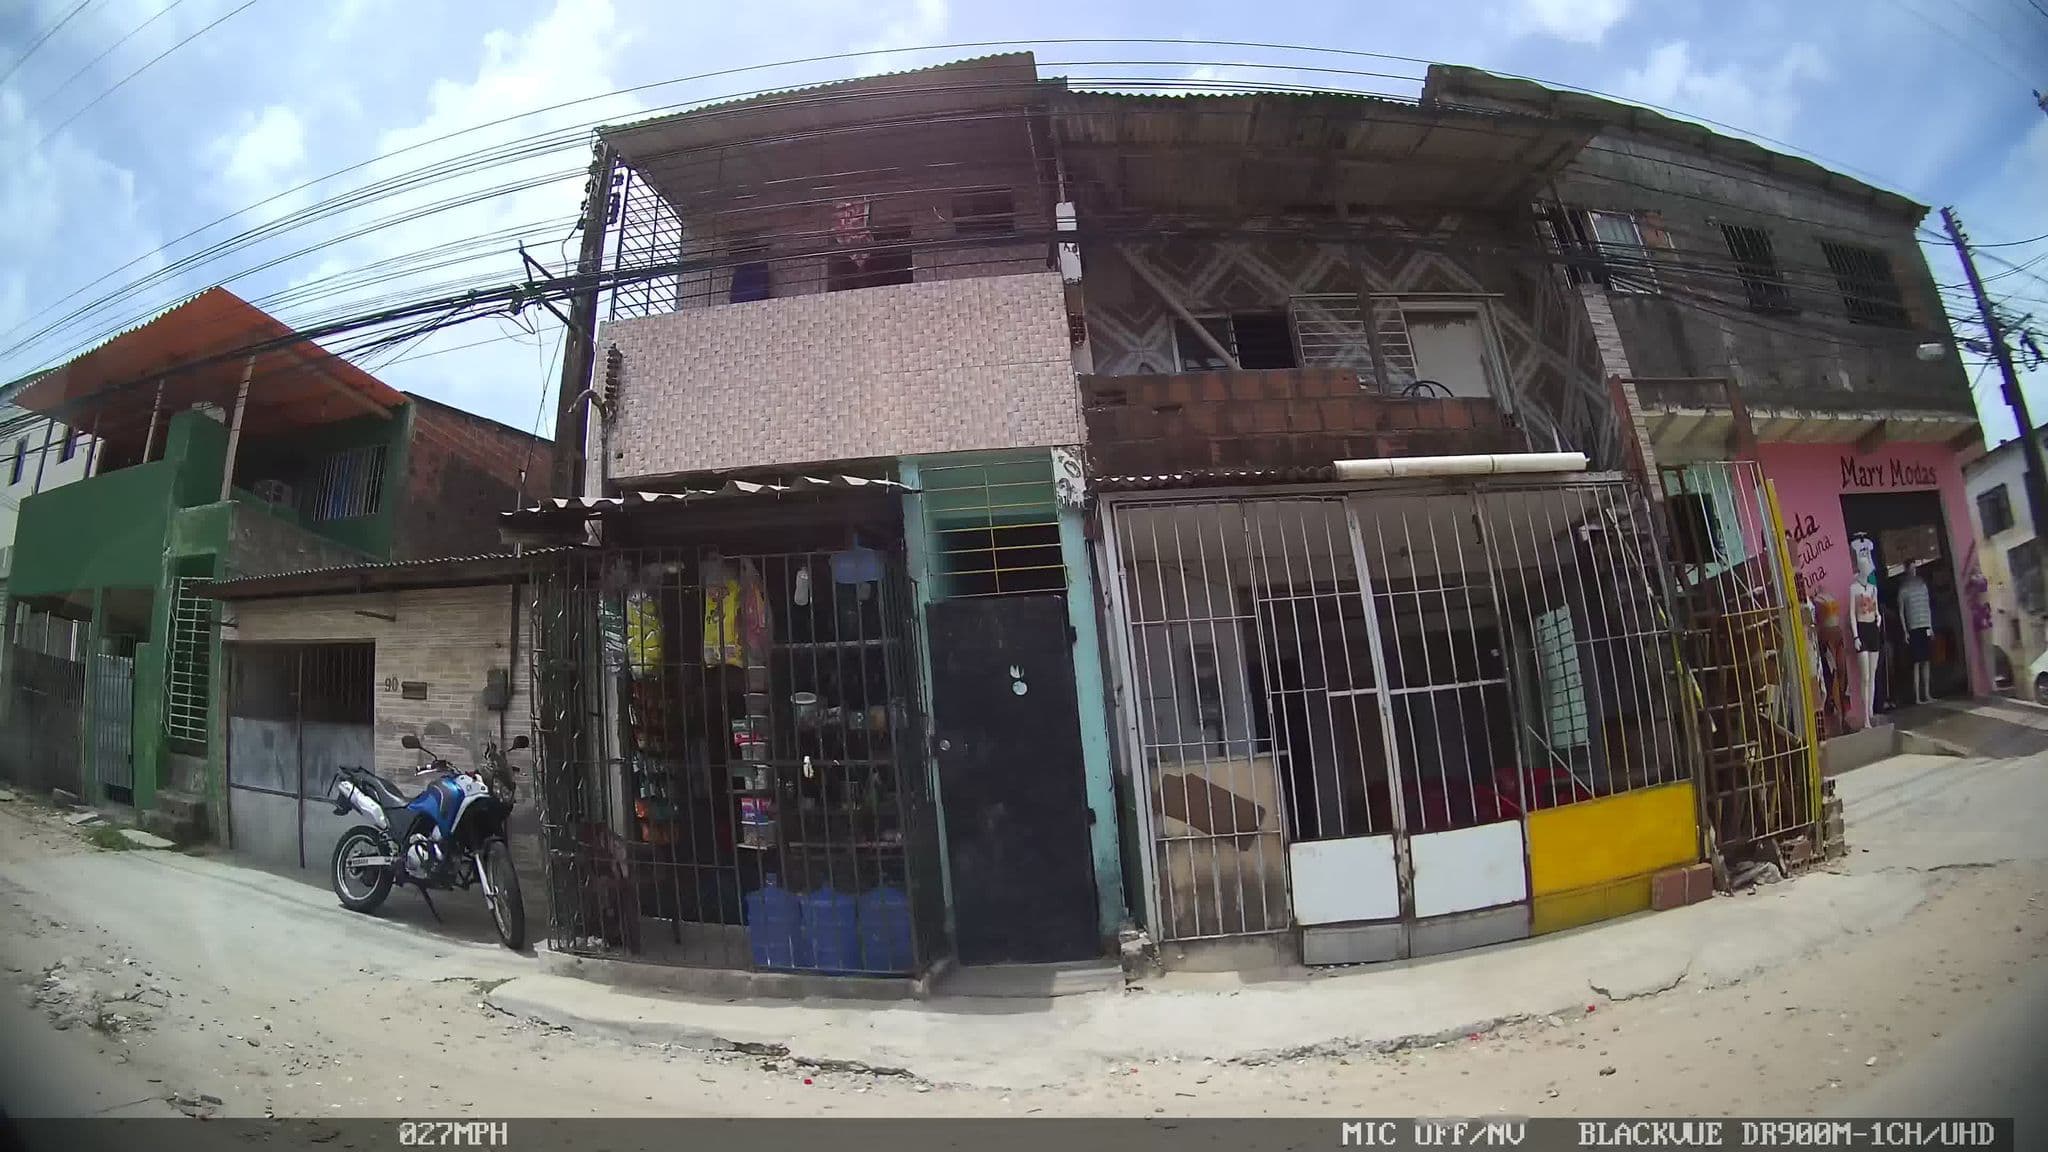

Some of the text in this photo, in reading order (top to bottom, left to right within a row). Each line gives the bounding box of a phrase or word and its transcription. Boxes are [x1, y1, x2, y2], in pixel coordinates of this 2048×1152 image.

[1840, 456, 1937, 489] Mary Modas
[384, 676, 400, 692] 90
